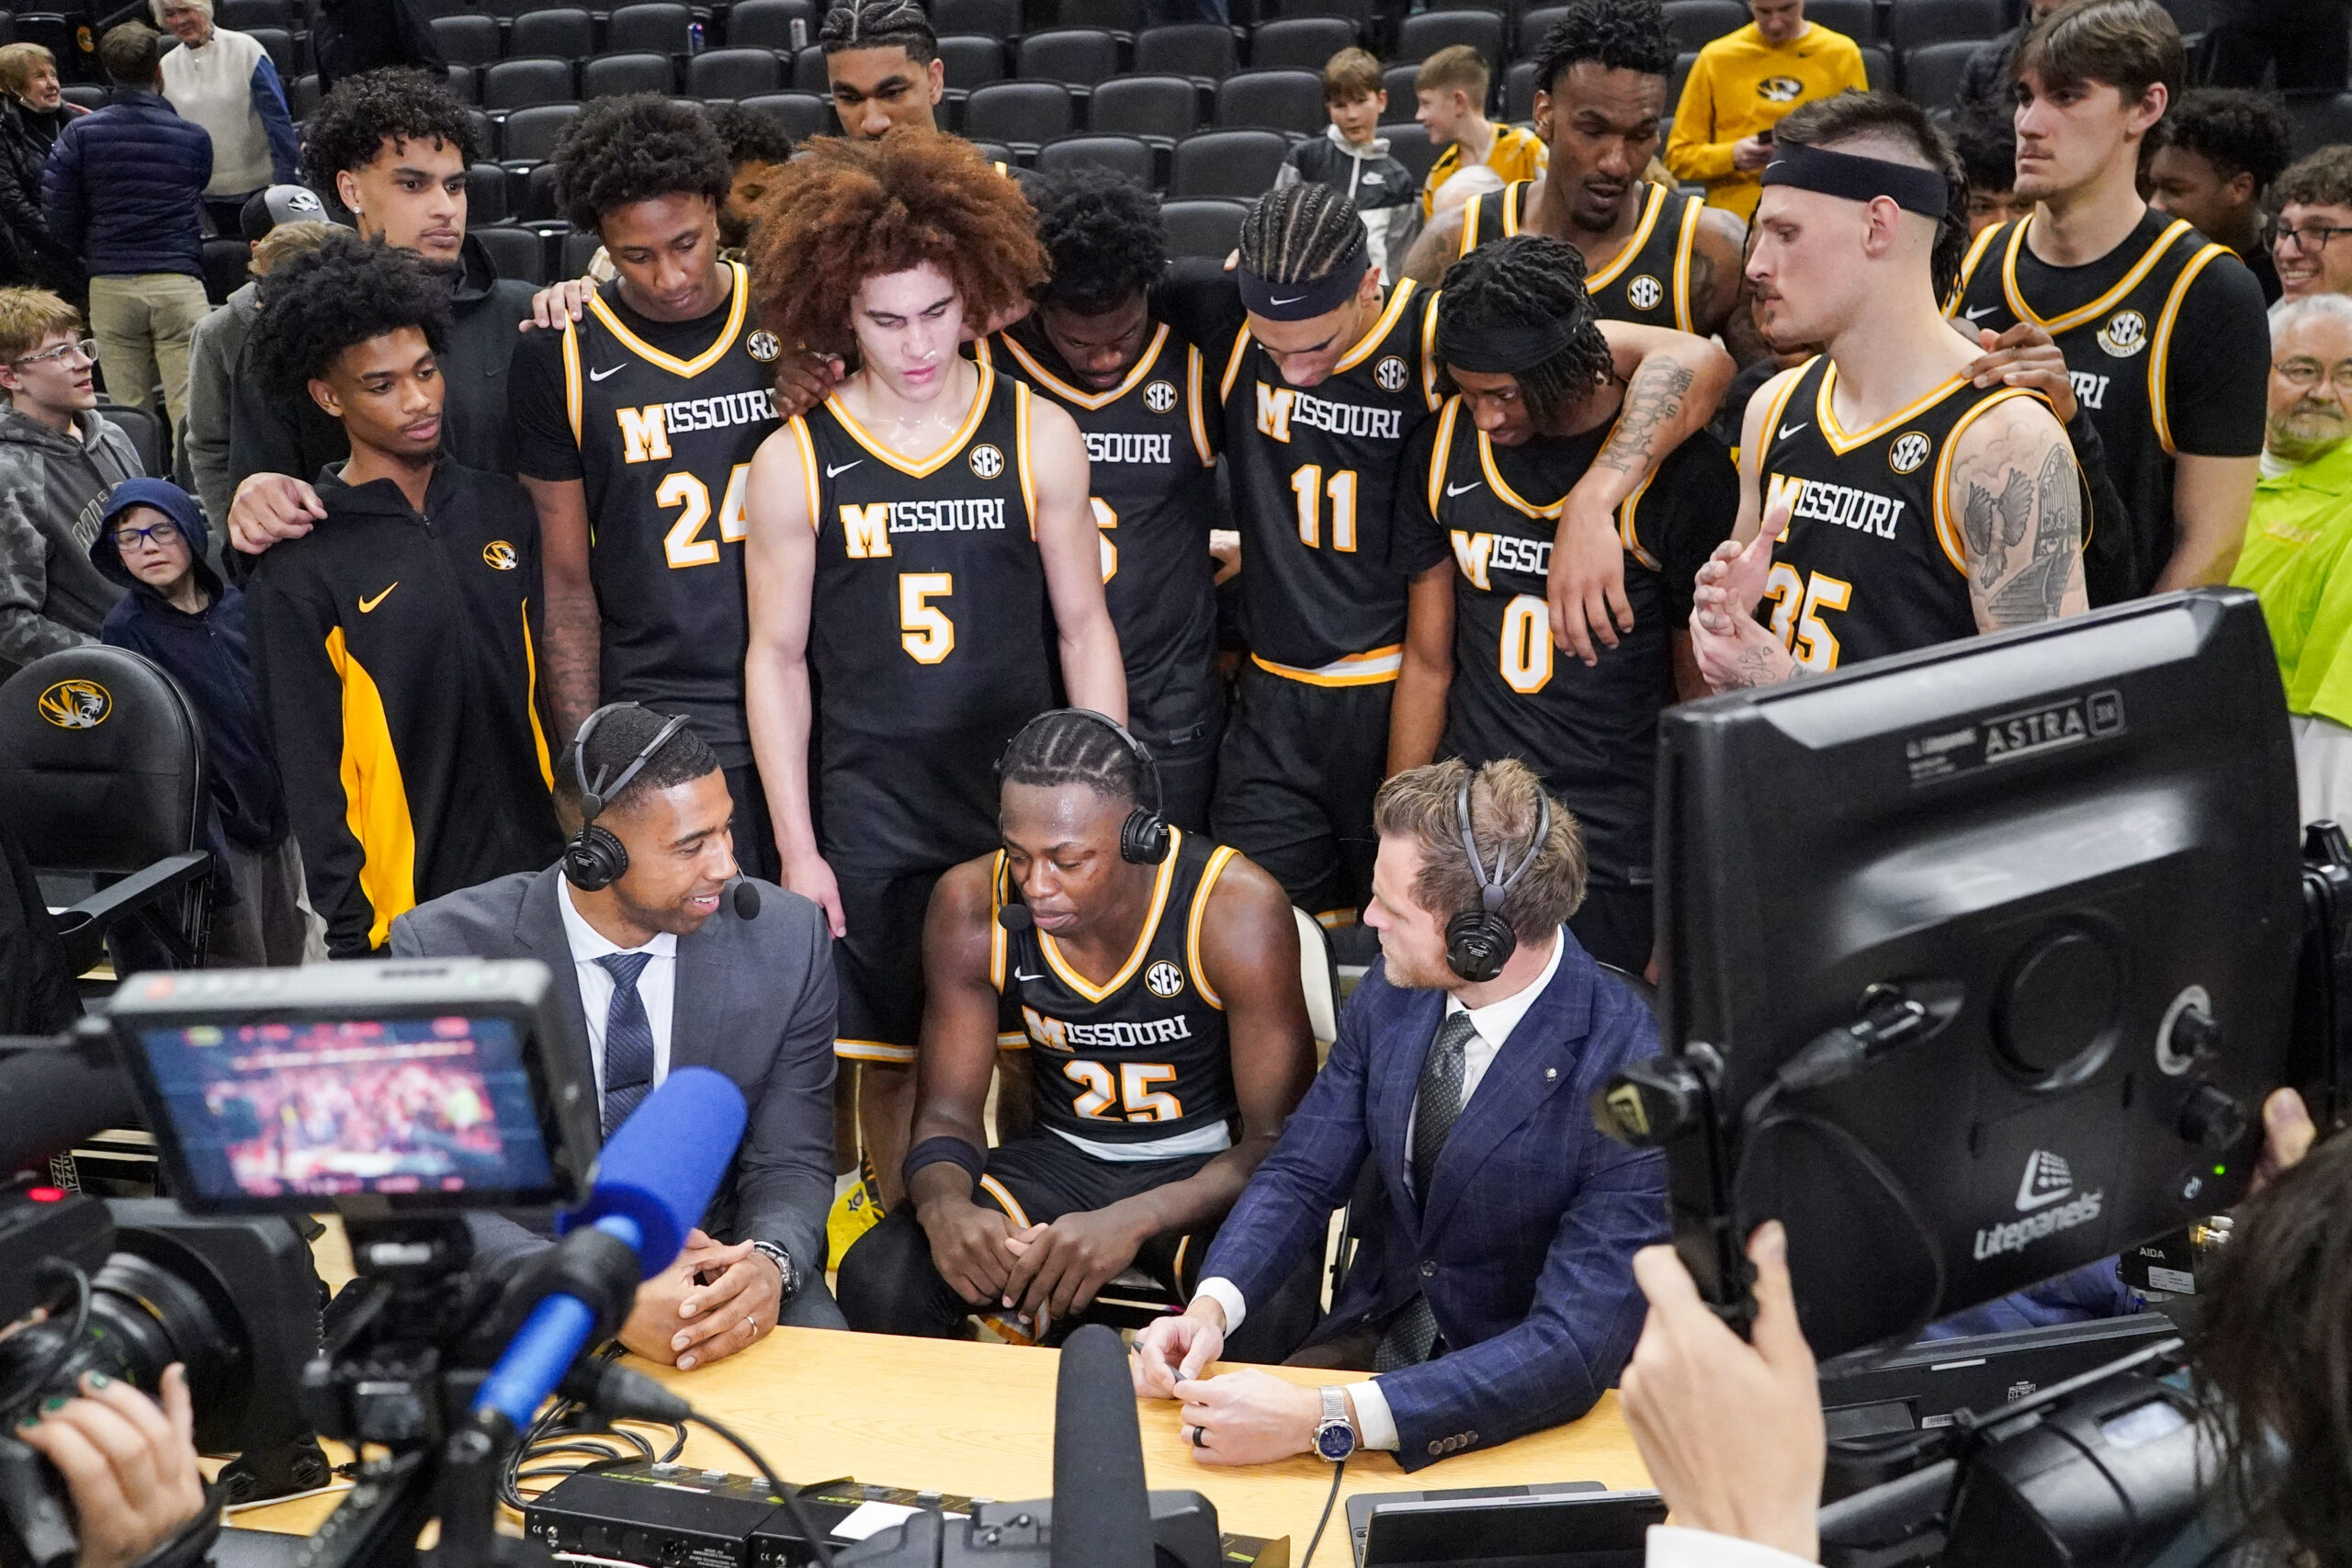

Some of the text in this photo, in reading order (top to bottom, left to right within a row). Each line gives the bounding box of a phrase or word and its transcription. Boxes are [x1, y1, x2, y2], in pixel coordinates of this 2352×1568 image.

[1631, 277, 1659, 308] SEC
[751, 332, 779, 360] SEC
[2109, 312, 2143, 344] SEC
[1147, 382, 1175, 412] SEC
[1377, 358, 1406, 389] SEC
[1256, 379, 1402, 444] MISSOURI
[972, 446, 1002, 477] SEC
[1892, 434, 1928, 471] SEC
[839, 498, 1005, 559] MISSOURI
[1291, 463, 1357, 553] 11
[1760, 472, 1905, 543] MISSOURI
[1451, 529, 1555, 591] MISSO
[899, 572, 956, 665] 5
[1763, 561, 1852, 673] 35
[1499, 593, 1555, 694] 0
[1984, 706, 2087, 756] ASTRA
[1148, 963, 1182, 996] SEC
[1022, 1005, 1193, 1053] MISSOURI
[1063, 1059, 1183, 1122] 25
[2139, 1247, 2166, 1259] AIDA
